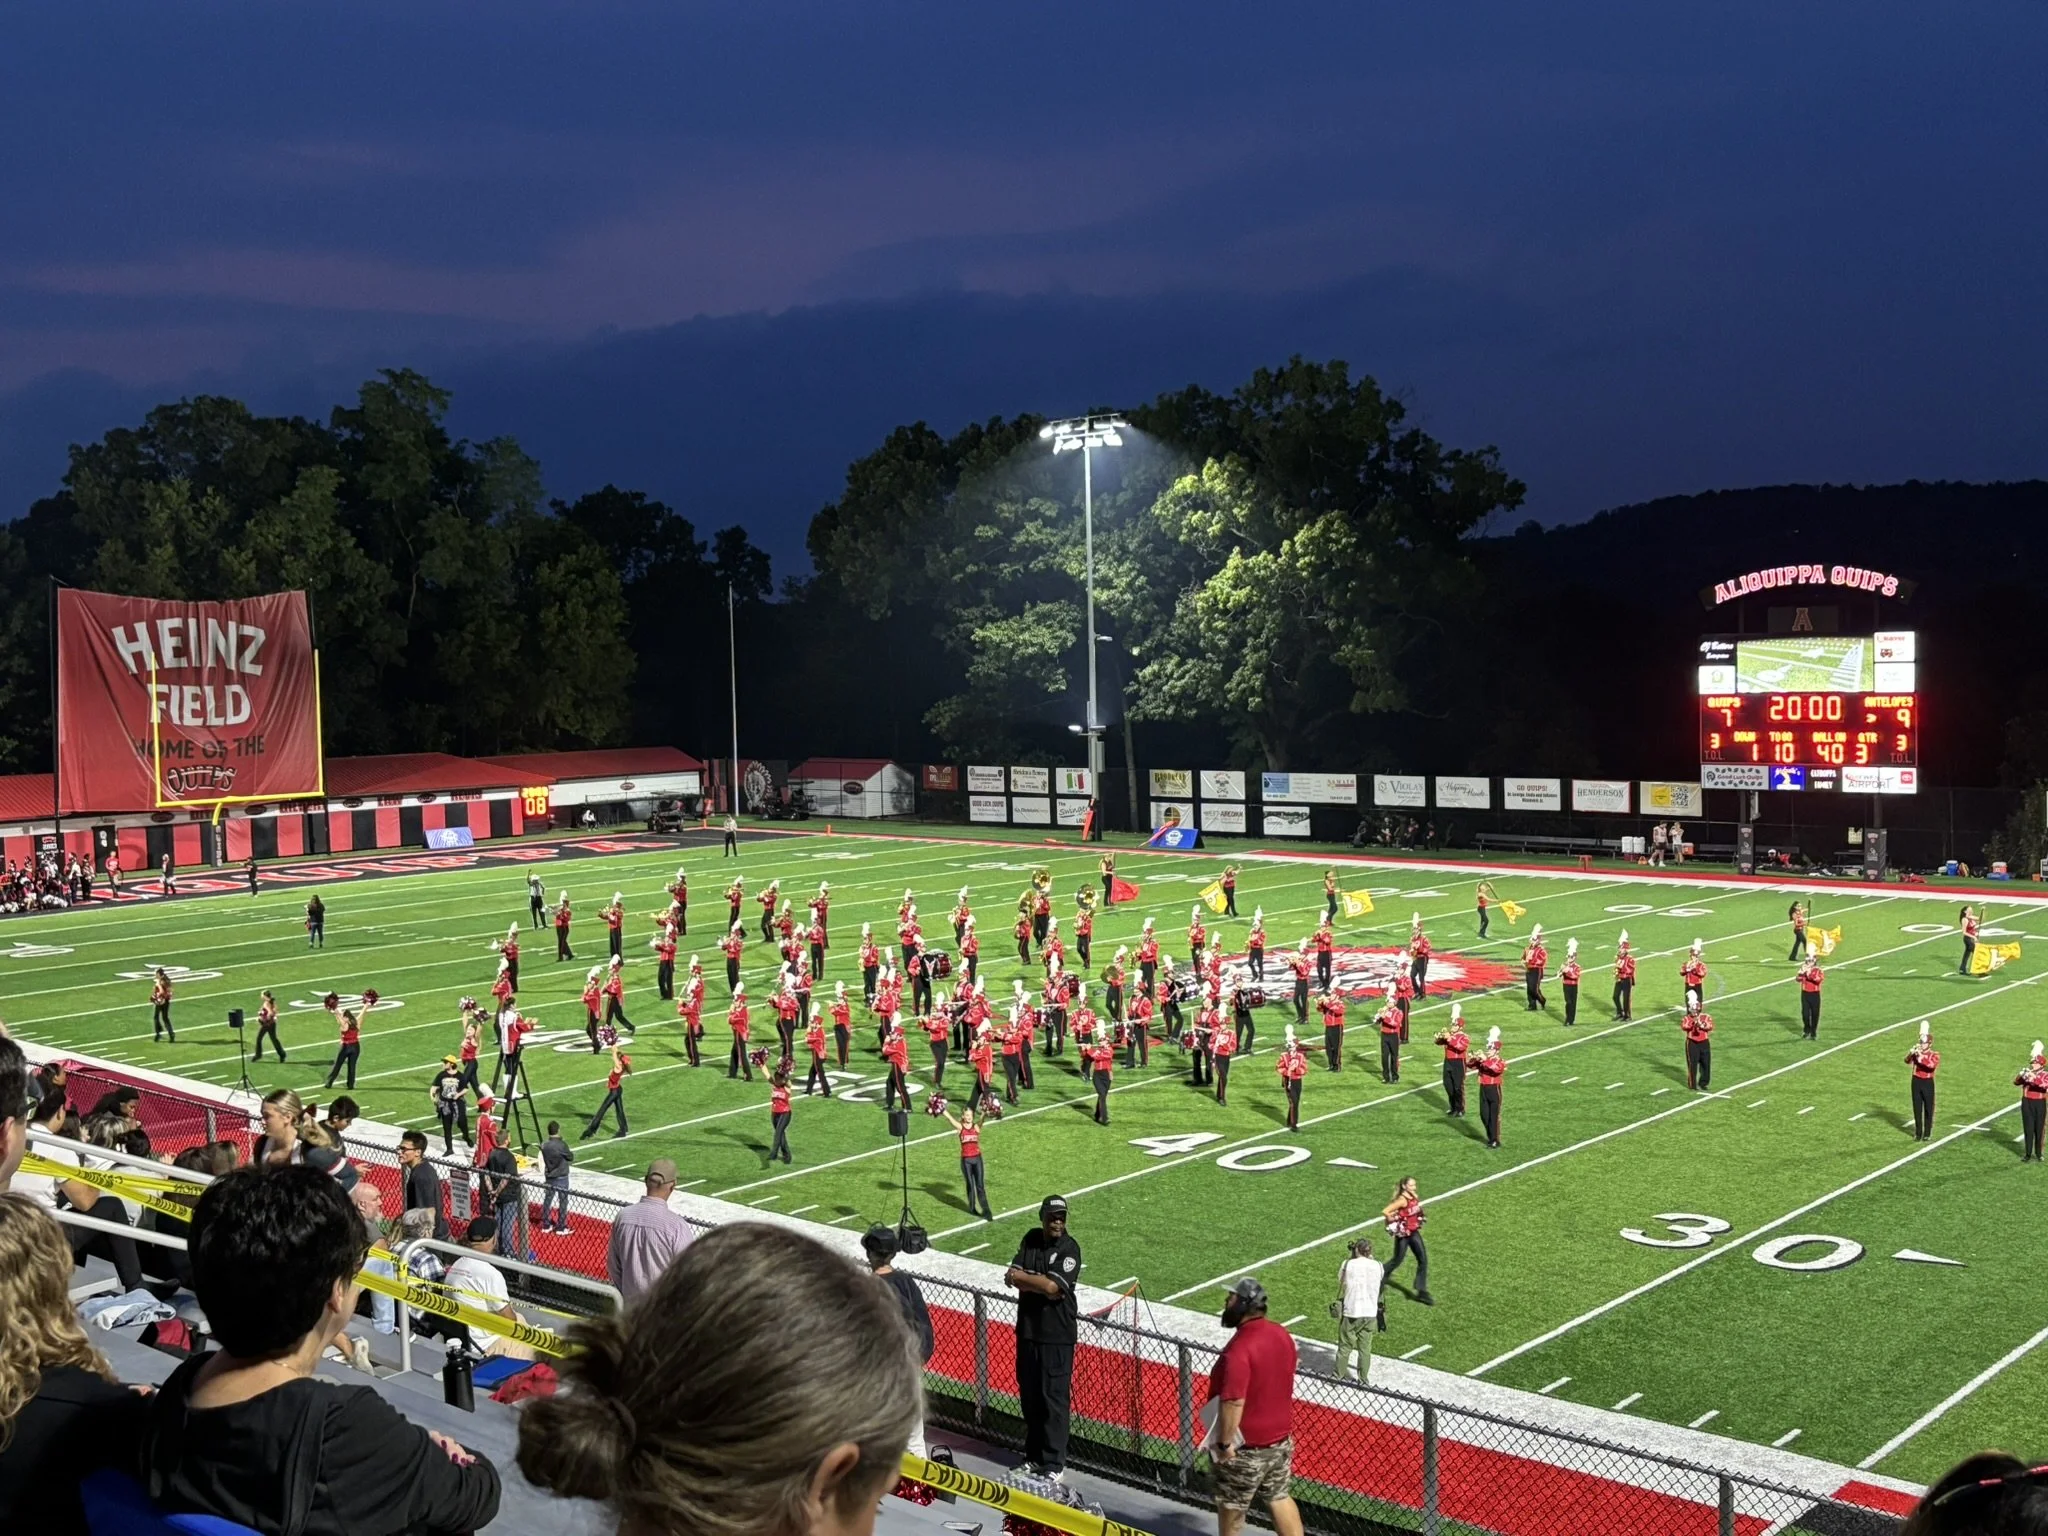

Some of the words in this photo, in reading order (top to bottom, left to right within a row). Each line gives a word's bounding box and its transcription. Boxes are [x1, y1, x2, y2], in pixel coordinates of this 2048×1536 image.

[1714, 564, 1825, 605] ALIQUIPPA
[1830, 565, 1899, 597] QUIPS
[1792, 607, 1813, 632] A
[111, 617, 267, 677] HEINZ
[146, 683, 252, 727] FIELD
[1707, 696, 1741, 708] QUIPS
[1720, 708, 1732, 727] 7
[1896, 708, 1911, 729] 9
[232, 734, 265, 758] THE
[1710, 732, 1720, 750] 3
[1733, 731, 1757, 742] DOWN
[1812, 731, 1834, 743] BALL
[1857, 731, 1878, 743] QTR
[1896, 734, 1907, 751] 3
[1752, 743, 1759, 762] 1
[1774, 742, 1795, 763] 10
[1816, 743, 1844, 764] 40
[1855, 743, 1868, 764] 3
[166, 765, 237, 796] QUIPS
[1389, 780, 1423, 794] VIOLA'S
[1526, 784, 1548, 792] QUIPS!
[1577, 786, 1624, 799] HENDERSON
[525, 798, 547, 816] 08
[1128, 1130, 1311, 1172] 40
[1618, 1211, 1867, 1272] 30
